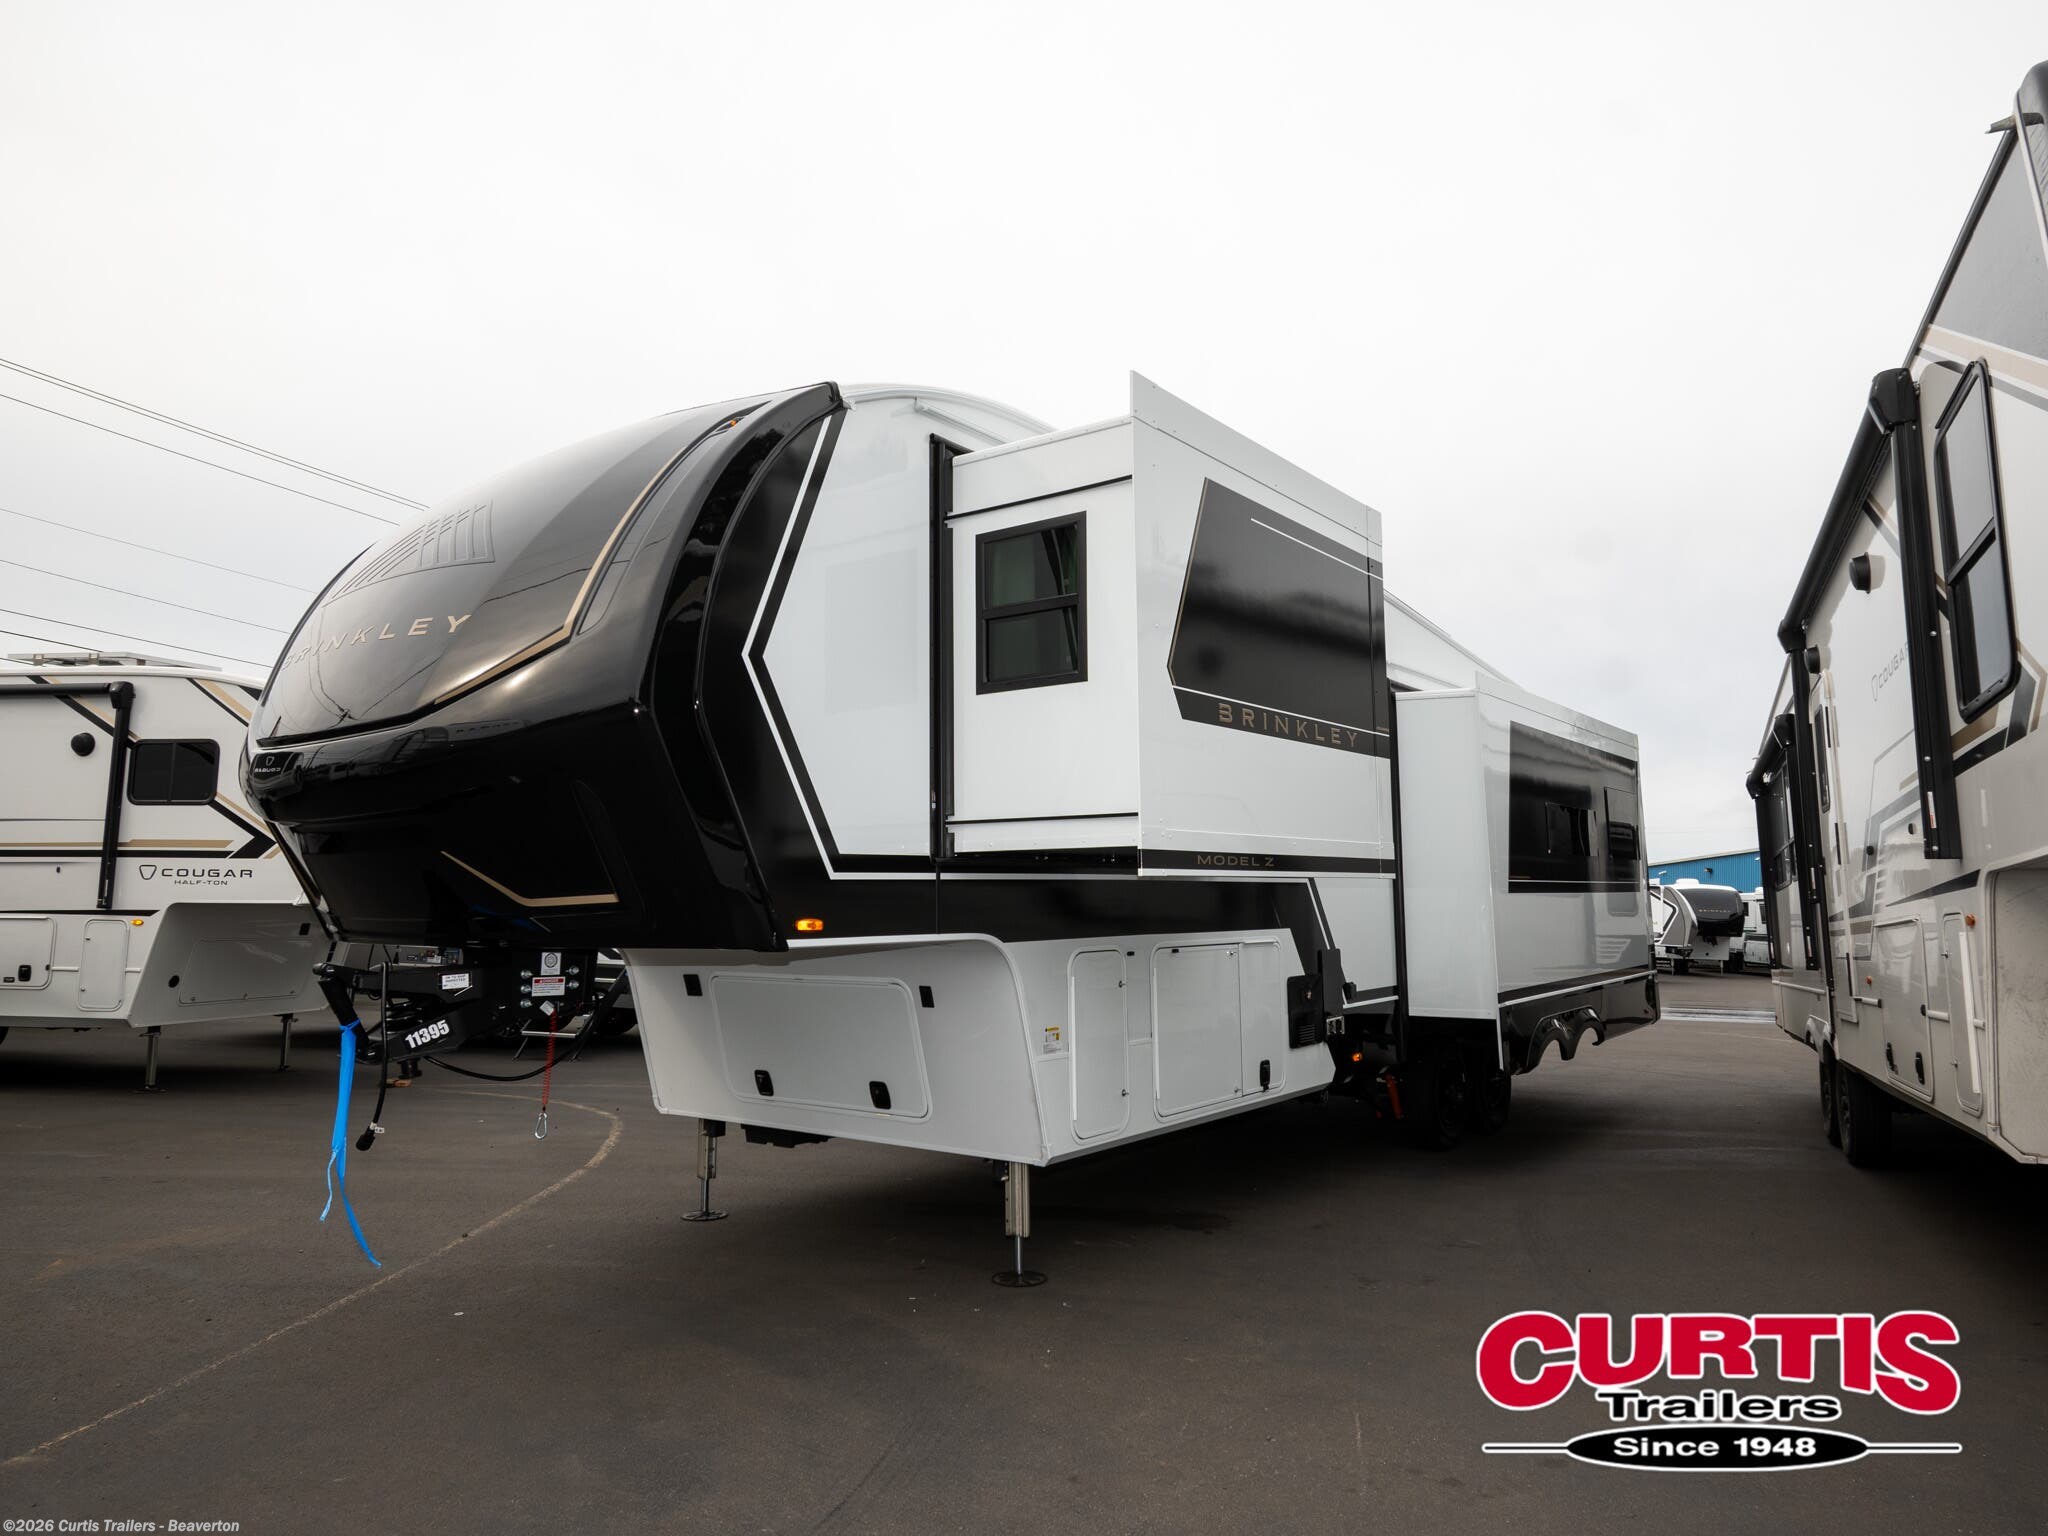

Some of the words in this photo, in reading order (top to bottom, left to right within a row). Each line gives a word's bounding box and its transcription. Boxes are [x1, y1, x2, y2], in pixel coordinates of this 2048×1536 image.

[1218, 702, 1358, 747] BRINKLEY
[1197, 854, 1260, 867] MODEL
[1264, 857, 1275, 867] Z
[161, 868, 253, 878] COUGAR
[405, 1019, 450, 1049] 11395
